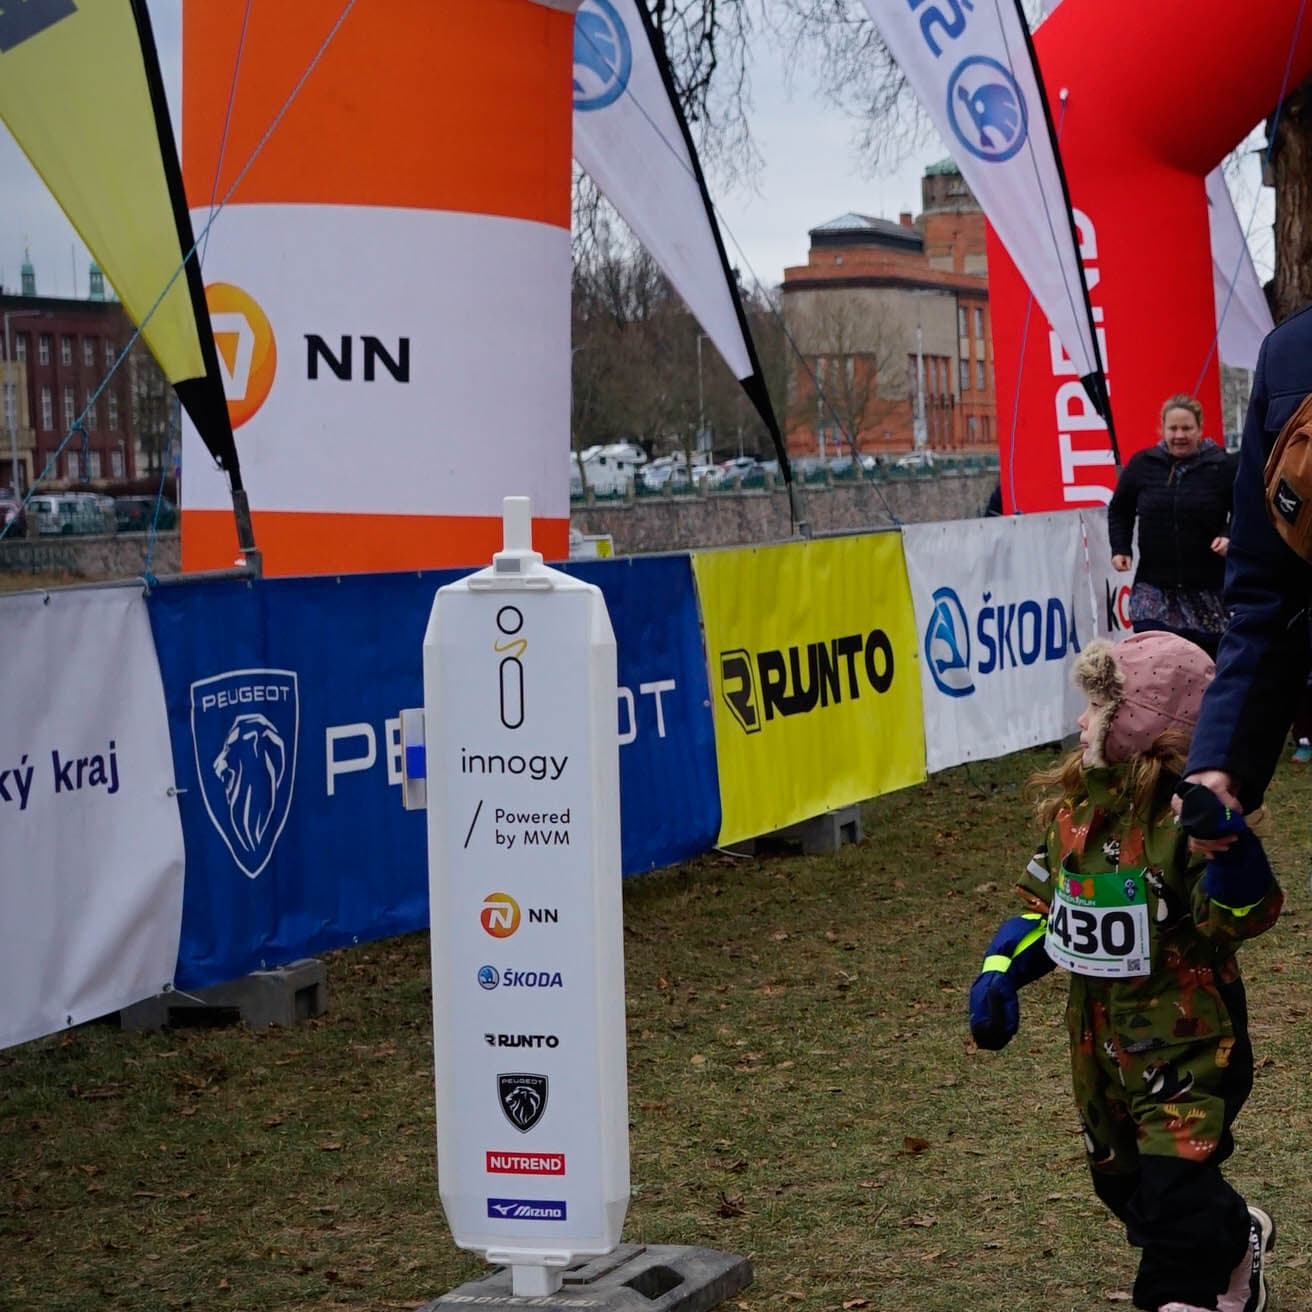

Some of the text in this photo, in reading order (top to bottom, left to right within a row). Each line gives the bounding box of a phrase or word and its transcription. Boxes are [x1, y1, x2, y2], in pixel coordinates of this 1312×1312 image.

[303, 333, 411, 384] NN
[977, 591, 1081, 674] ŠKODA
[757, 628, 895, 722] RUNTO
[202, 685, 290, 713] PEUGEOT
[51, 740, 120, 795] kraj
[460, 747, 569, 781] innogy
[495, 808, 571, 825] Powered
[495, 830, 570, 850] by MVM
[528, 908, 559, 924] NN
[1048, 898, 1136, 957] 430
[502, 967, 564, 988] ŠKODA
[498, 1034, 560, 1048] RUNTO
[501, 1077, 544, 1086] PEUGEOT
[489, 1156, 562, 1171] NUTREND
